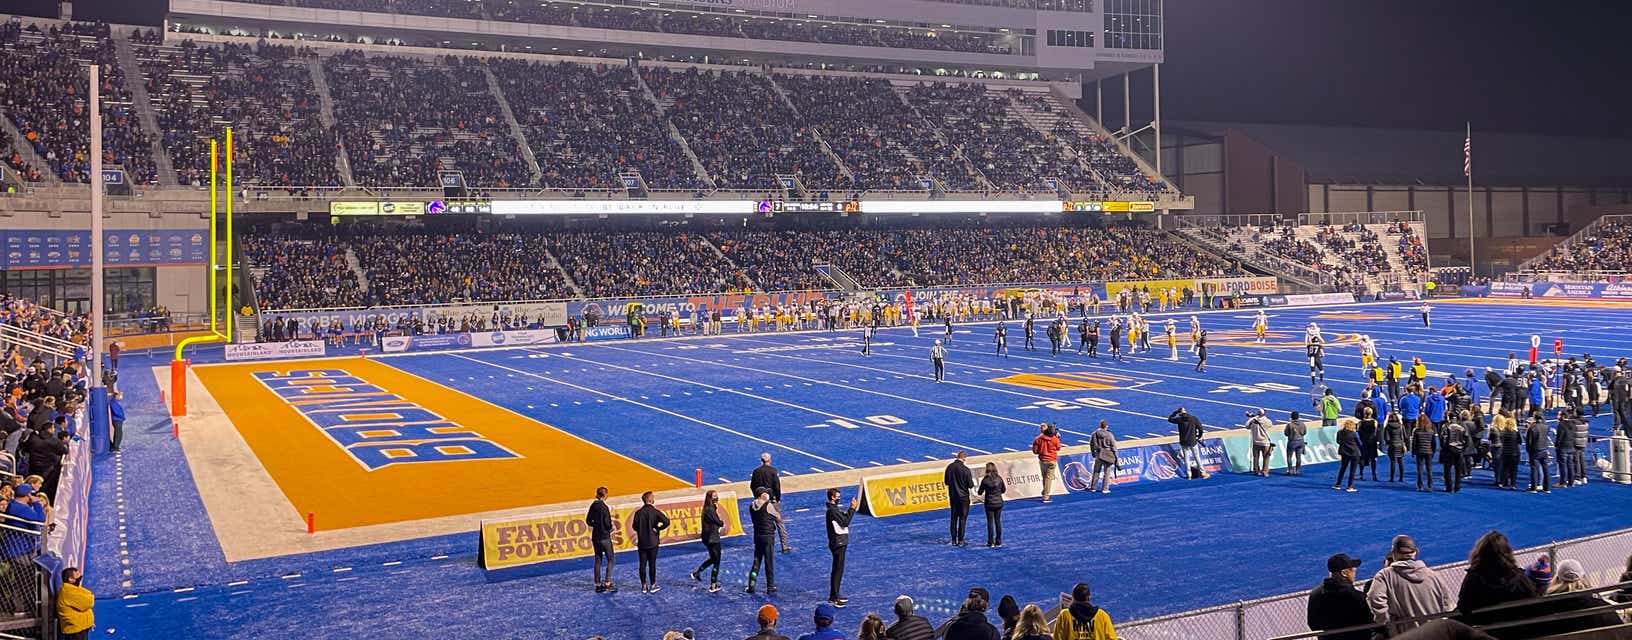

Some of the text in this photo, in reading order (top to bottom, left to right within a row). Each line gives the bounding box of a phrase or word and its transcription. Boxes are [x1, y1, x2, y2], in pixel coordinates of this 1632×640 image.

[677, 302, 693, 313] TO
[251, 368, 527, 472] BRONCOS
[1027, 473, 1040, 483] FOR
[908, 481, 946, 494] WESTE
[911, 492, 948, 505] STATES
[496, 513, 622, 546] FAMOS
[498, 532, 624, 561] POTATOS
